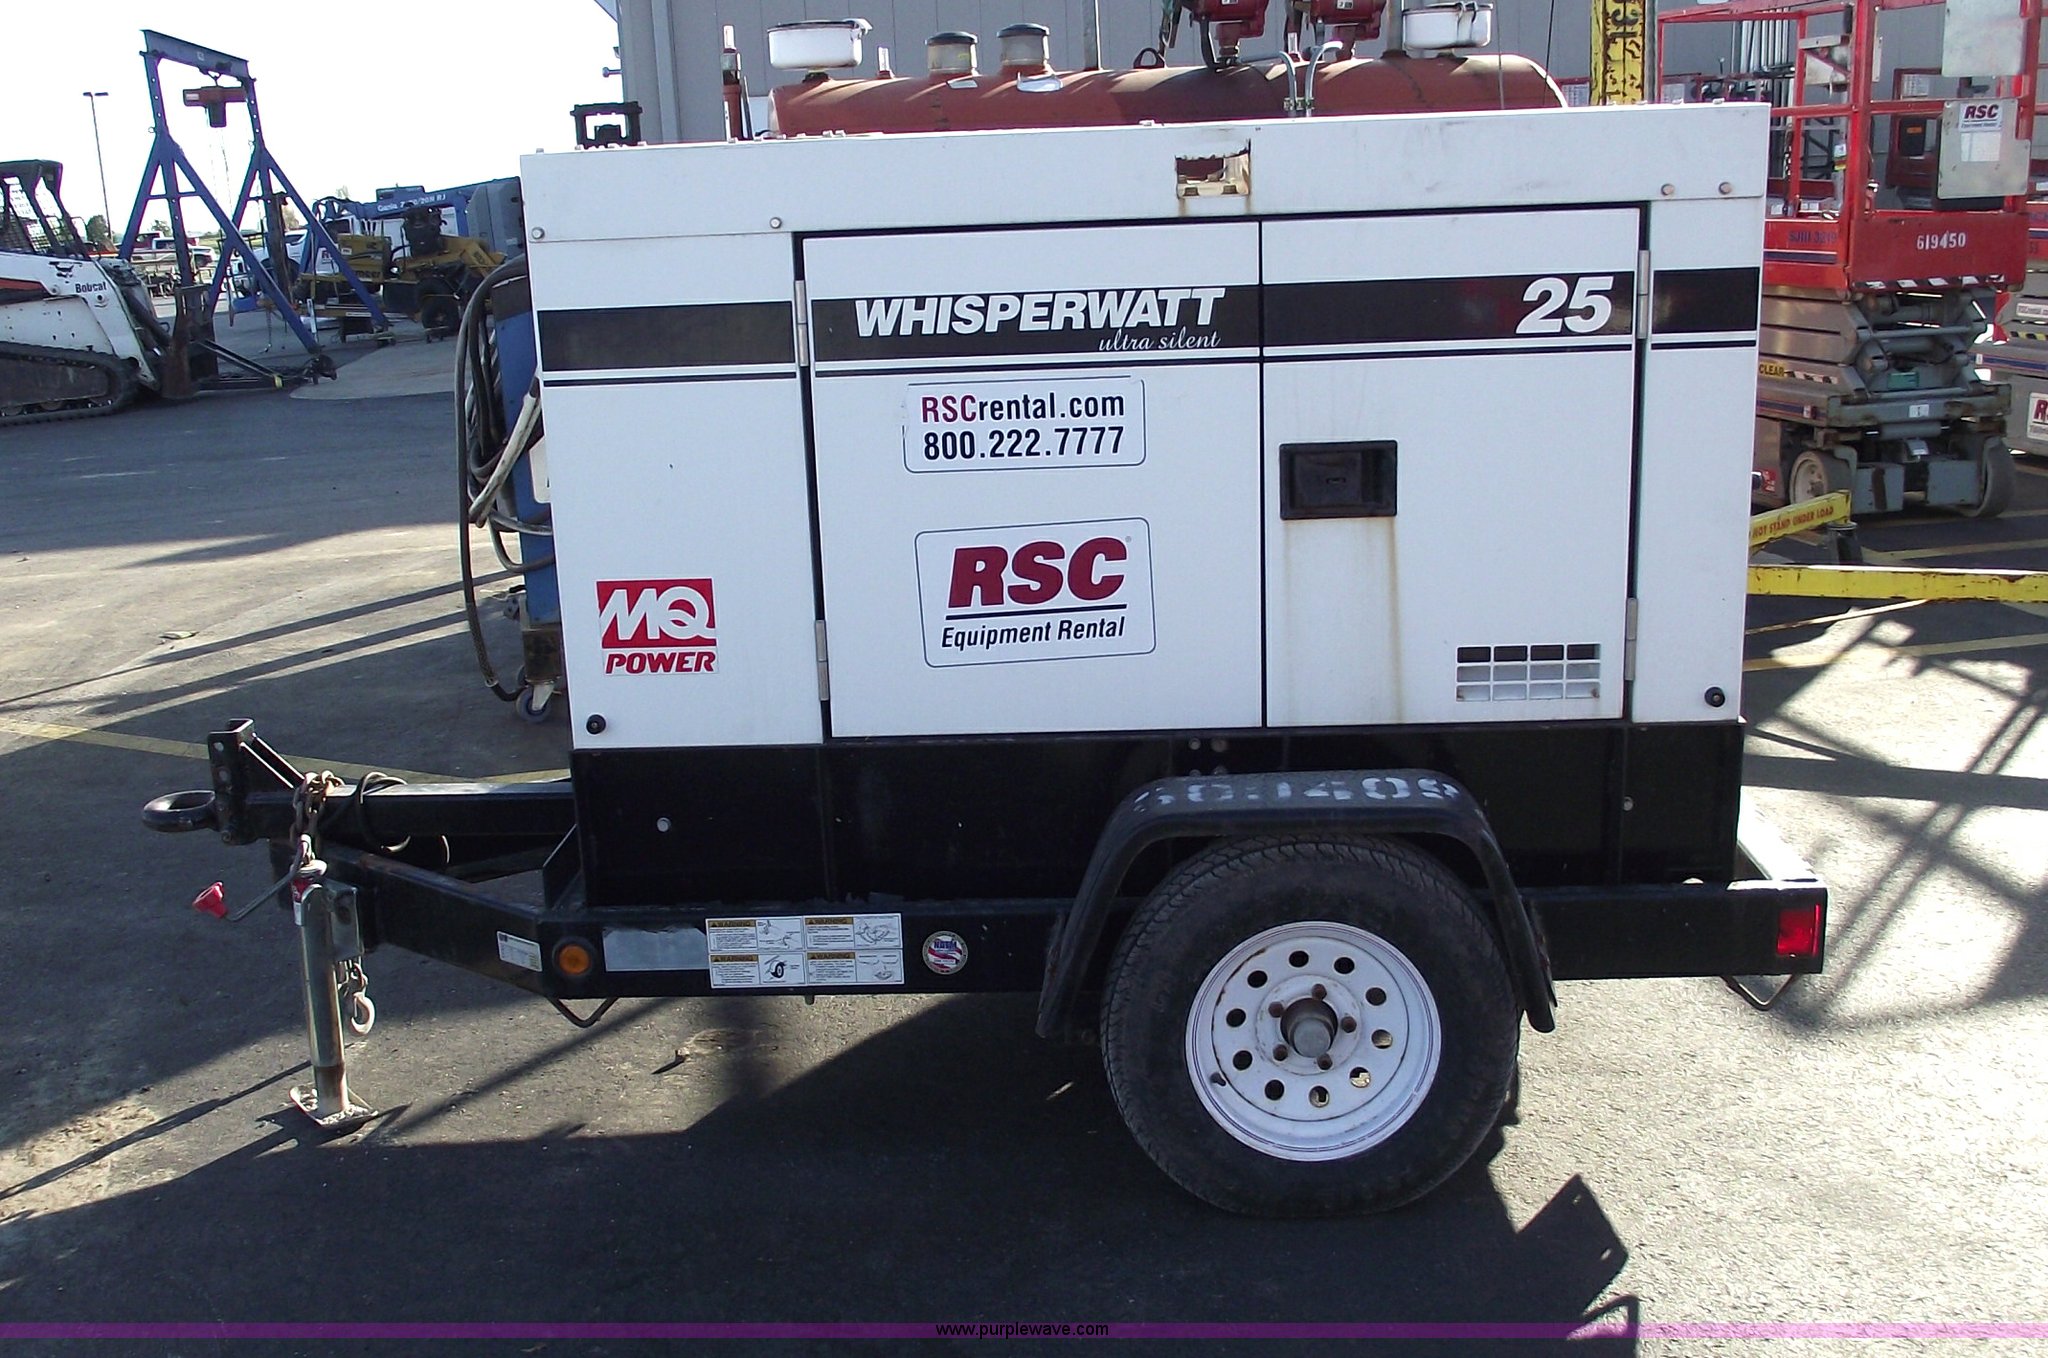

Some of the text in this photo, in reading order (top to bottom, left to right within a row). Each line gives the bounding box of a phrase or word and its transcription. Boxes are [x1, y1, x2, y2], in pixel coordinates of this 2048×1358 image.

[1964, 104, 1999, 119] RSC
[1917, 232, 1966, 250] 619450
[75, 281, 107, 293] Bobcat
[855, 287, 1225, 337] WHISPERWATT
[1515, 276, 1614, 335] 25
[1098, 326, 1221, 351] ultra silent
[1759, 364, 1785, 377] CLEAR
[921, 392, 1125, 423] RSCrental.com
[924, 426, 1124, 460] 800.222.7777
[1770, 518, 1790, 532] STAND
[1792, 511, 1814, 526] UNDER
[1816, 506, 1834, 519] LOAD
[948, 536, 1127, 608] RSC
[599, 586, 717, 640] MQ
[941, 616, 1125, 651] Equipment Rental
[605, 652, 716, 674] POWER
